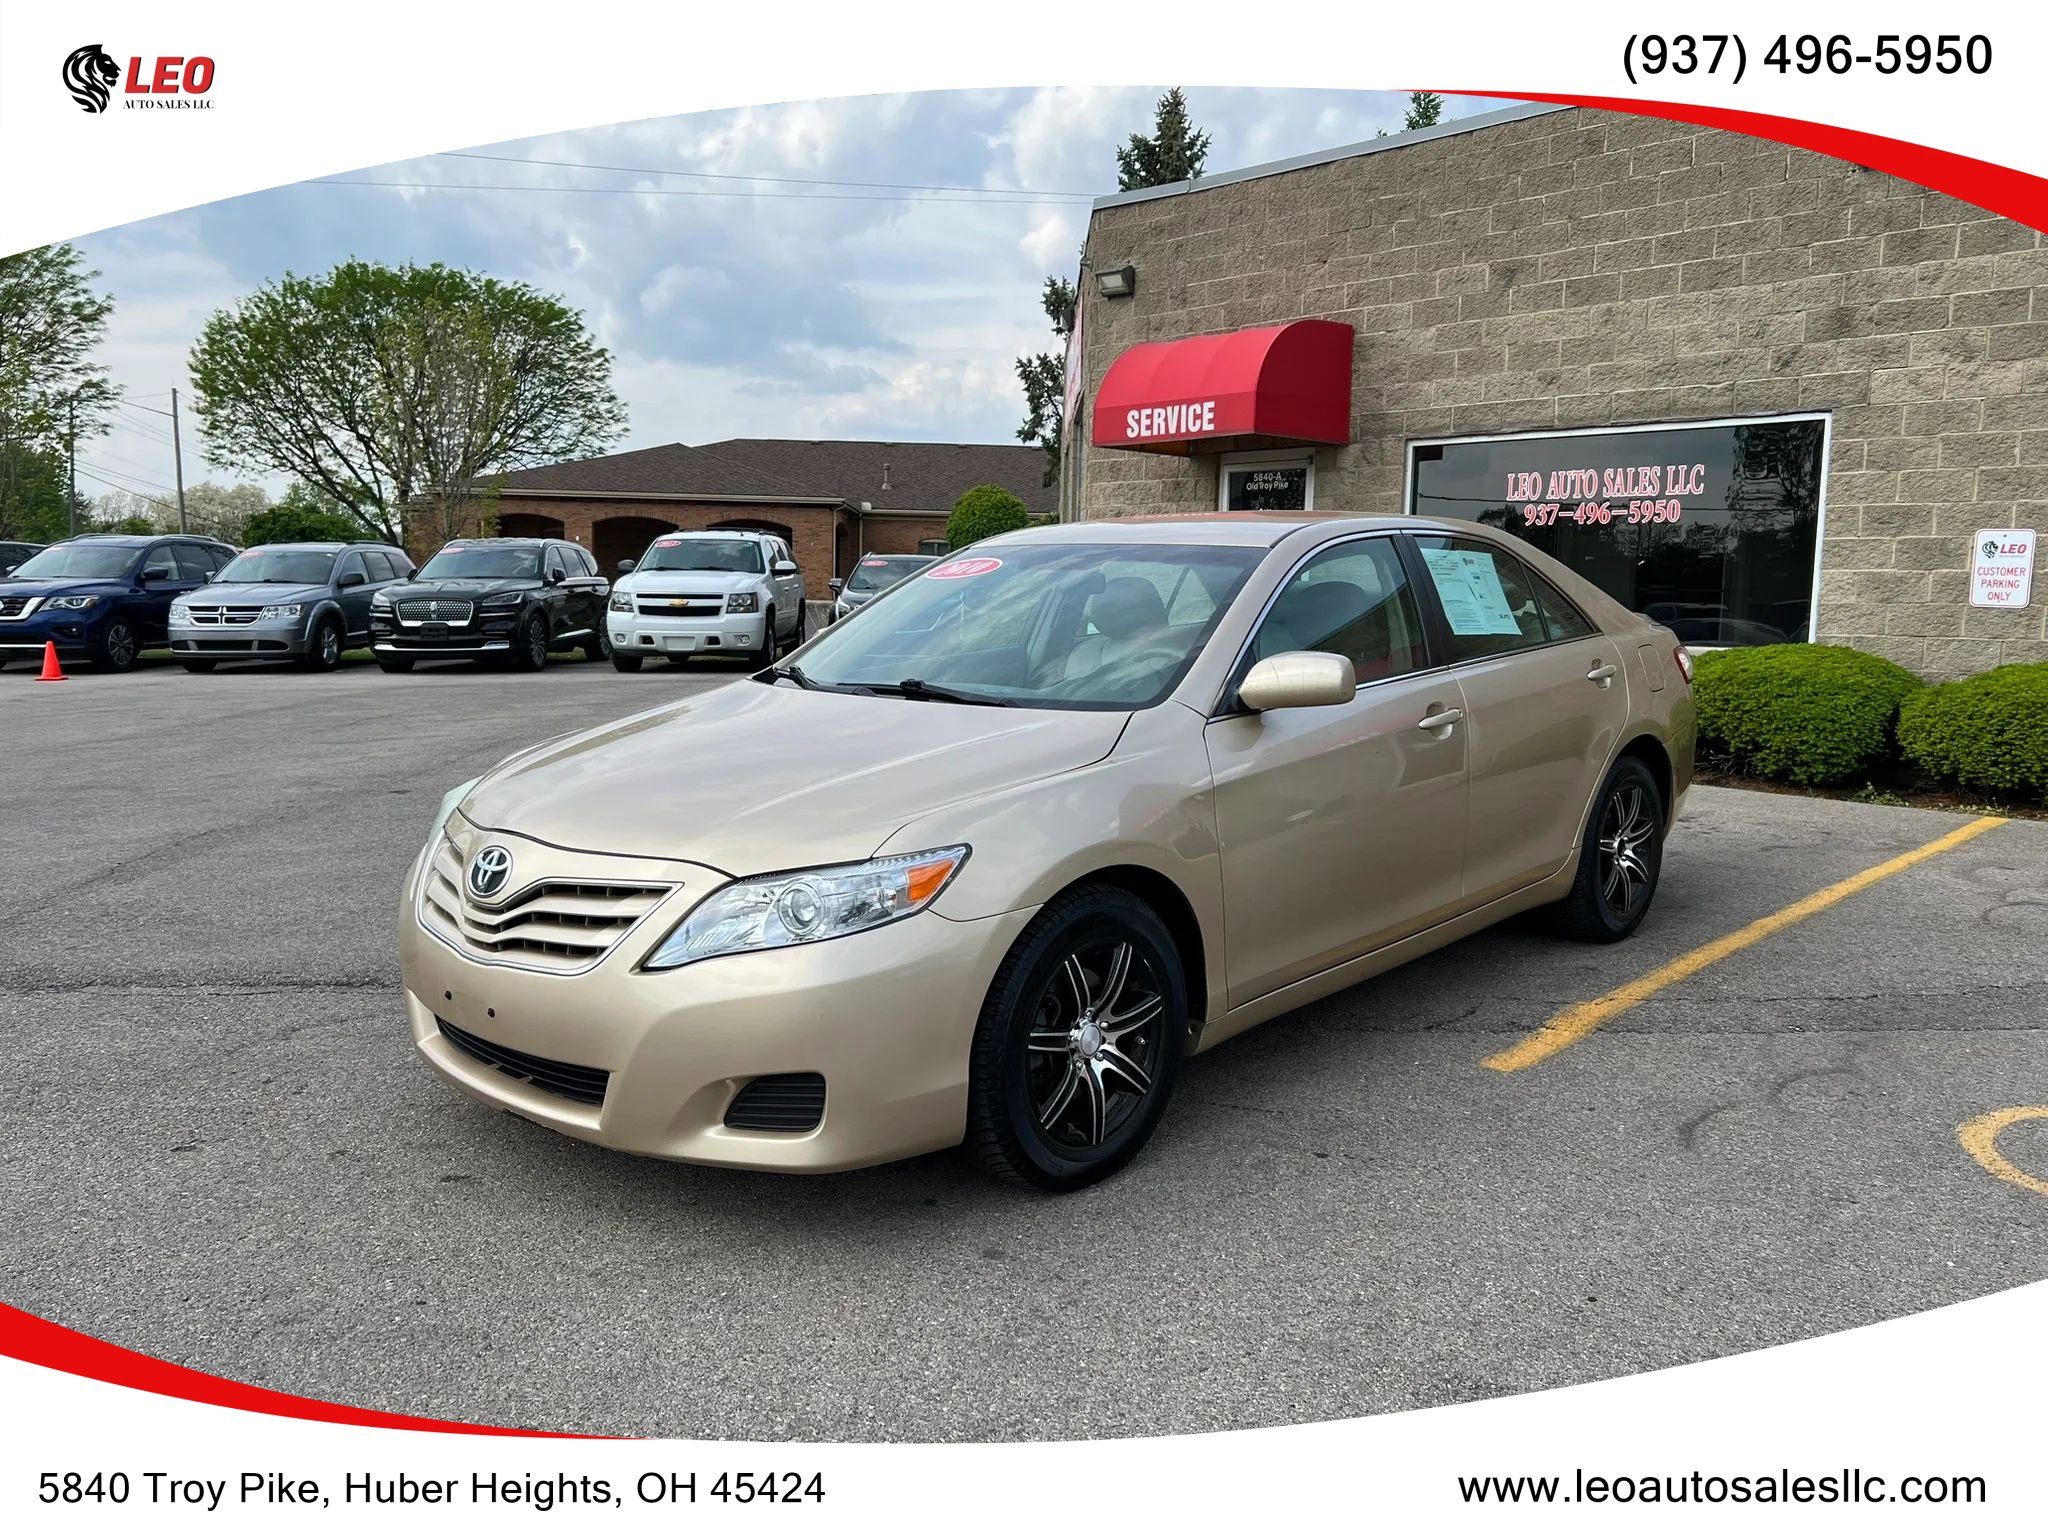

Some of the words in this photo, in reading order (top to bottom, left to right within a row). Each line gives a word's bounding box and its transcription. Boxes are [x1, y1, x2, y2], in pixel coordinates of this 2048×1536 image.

[1126, 401, 1215, 438] SERVICE
[1254, 472, 1282, 482] 5840-A
[1259, 481, 1273, 491] Troy
[1274, 481, 1289, 489] Pike
[1506, 472, 1542, 501] LEO
[1546, 468, 1598, 499] AUTO
[1603, 465, 1660, 498] SALES
[1666, 464, 1705, 496] LLC
[1524, 499, 1681, 526] 937-496-5950
[2000, 544, 2027, 554] LEO
[1977, 567, 2025, 576] CUSTOMER
[1981, 579, 2020, 589] PARKING
[1987, 591, 2012, 601] ONLY
